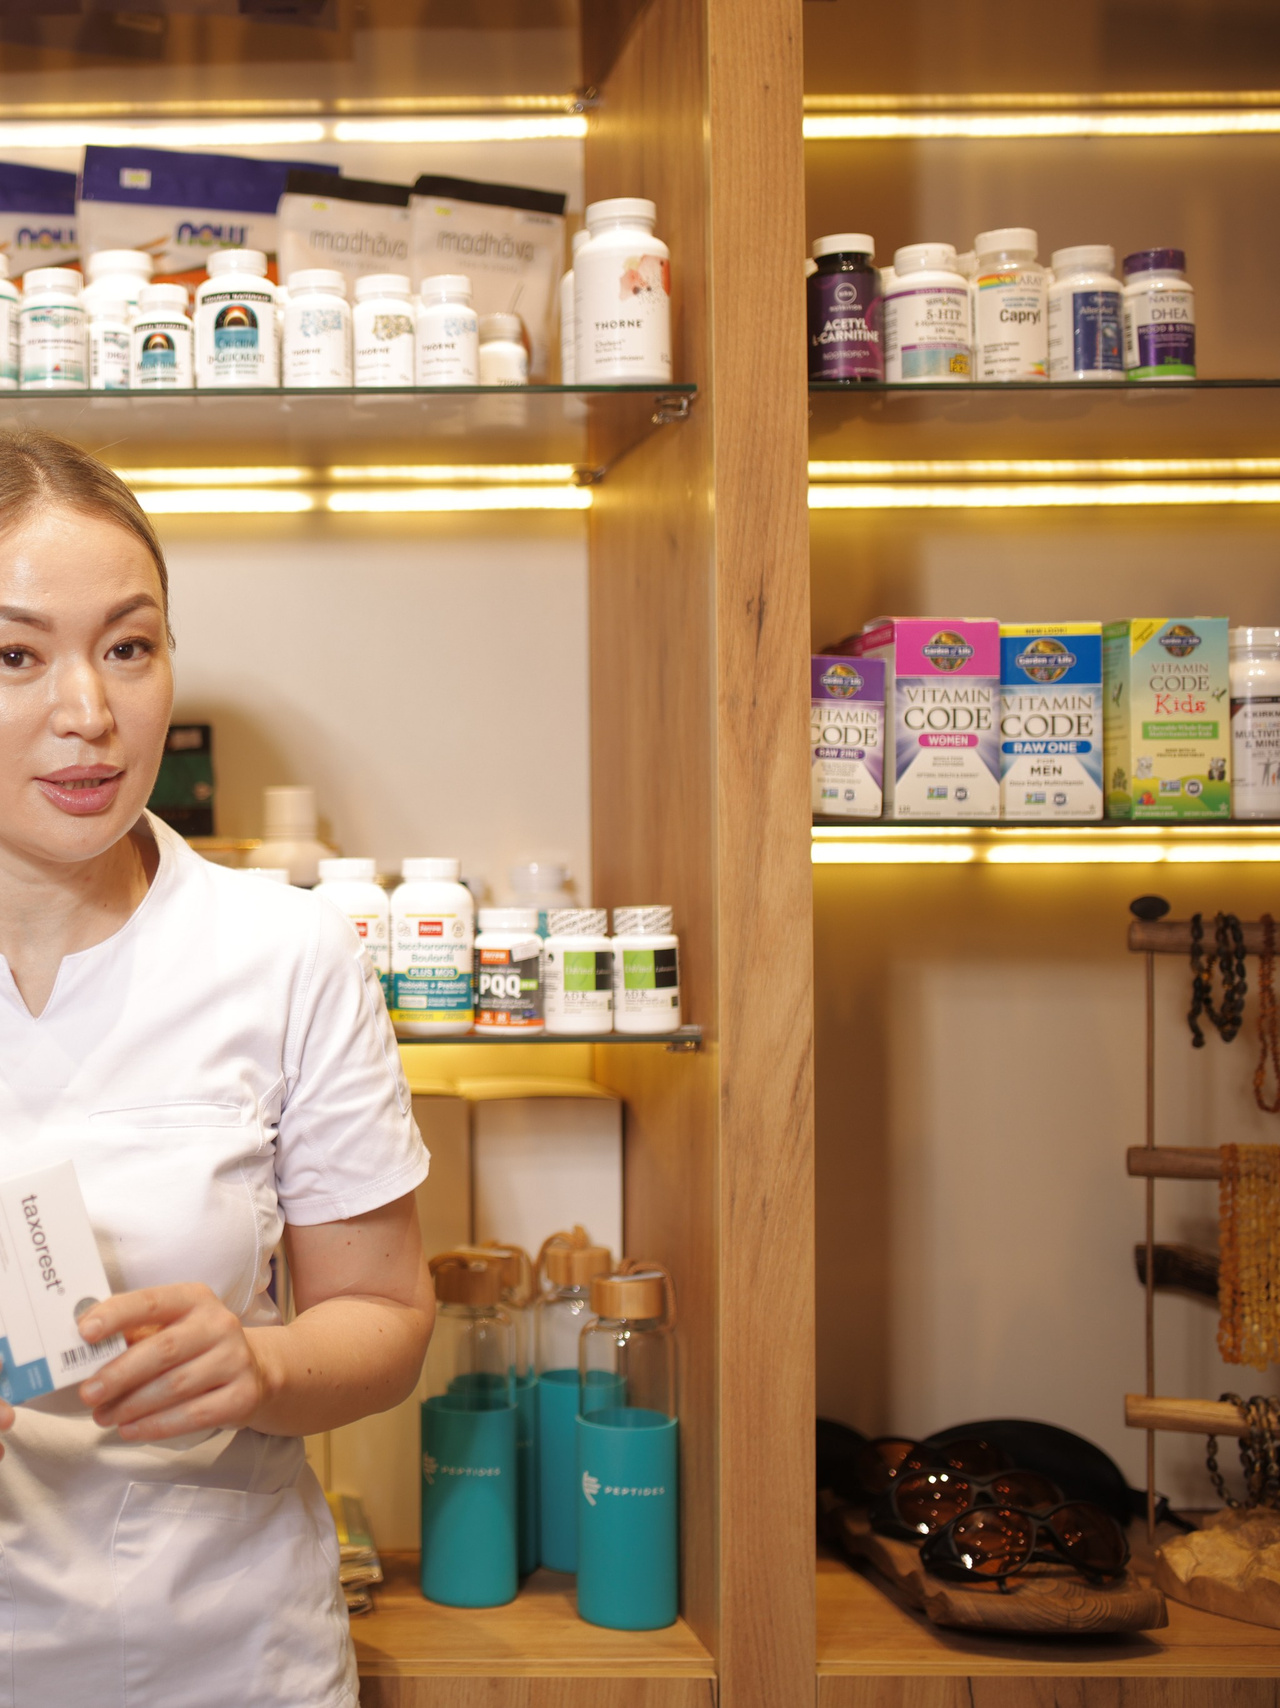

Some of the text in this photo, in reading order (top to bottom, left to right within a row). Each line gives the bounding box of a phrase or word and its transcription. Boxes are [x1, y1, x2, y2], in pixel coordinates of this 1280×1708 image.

[1000, 308, 1041, 325] Capryl
[1152, 308, 1188, 320] DHEA
[595, 319, 643, 330] THORNE
[824, 318, 868, 331] ACETYL
[1151, 663, 1209, 673] VITAMIN
[1149, 675, 1210, 692] CODE
[907, 688, 991, 703] VITAMIN
[1001, 696, 1092, 711] VITAMIN
[1154, 693, 1206, 714] Kids
[811, 710, 878, 724] VITAMIN
[904, 707, 992, 730] CODE
[1001, 714, 1094, 738] CODE
[811, 725, 878, 746] CODE
[928, 735, 969, 746] WOMEN
[1013, 742, 1077, 754] RAW ONE
[1030, 766, 1063, 776] MEN
[480, 974, 522, 998] PQQ
[441, 1466, 501, 1477] PEPTIDES
[604, 1486, 666, 1497] PEPTIDES
